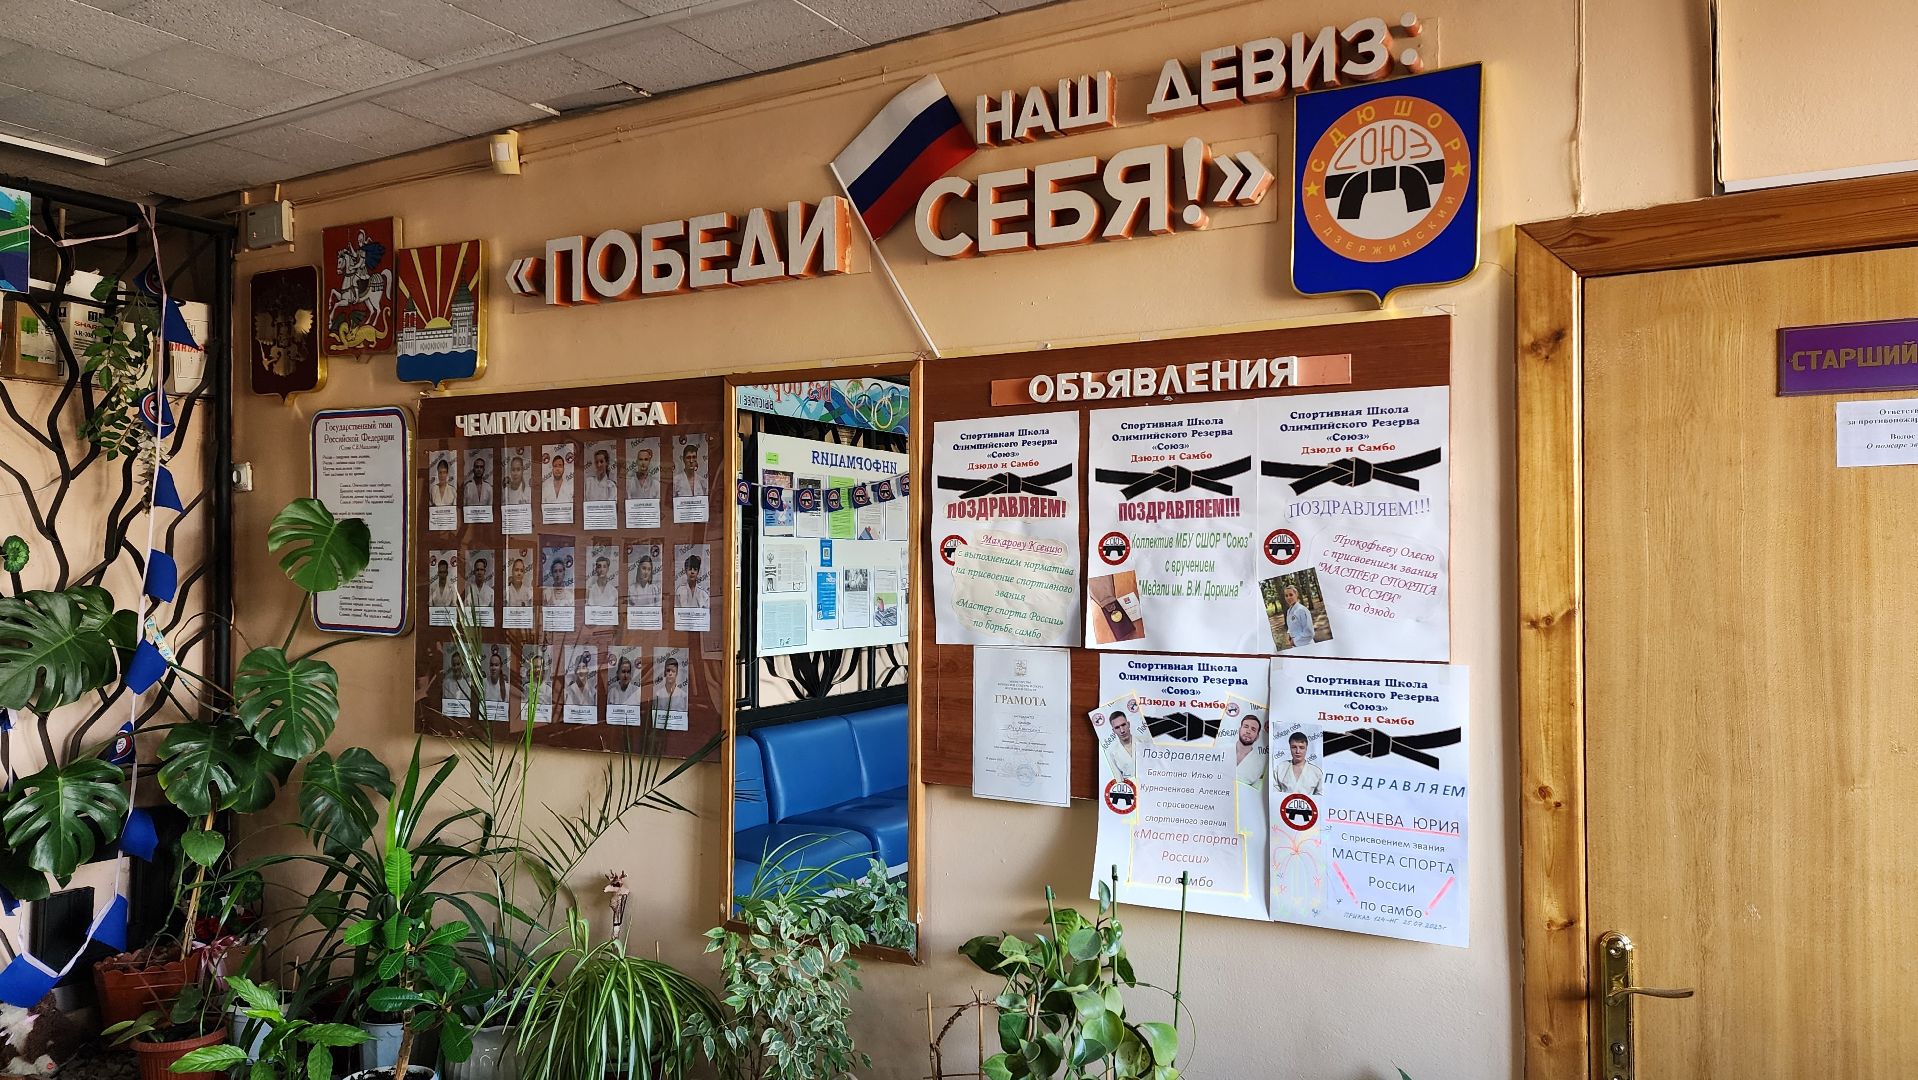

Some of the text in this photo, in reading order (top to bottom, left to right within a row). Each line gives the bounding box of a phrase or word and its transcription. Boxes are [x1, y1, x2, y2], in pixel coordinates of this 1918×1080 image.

[976, 12, 1422, 145] НАШ ДЕВИЗ:
[1310, 100, 1461, 173] СДЮШОР
[1334, 124, 1432, 170] СОЮЗ
[505, 137, 1274, 305] «ПОБЕДИ СЕБЯ!»
[74, 320, 101, 330] SHAR
[1791, 340, 1918, 371] СТАРШИЙ
[1029, 356, 1298, 404] ОБЪЯВЛЕНИЯ
[456, 401, 667, 437] ЧЕМПИОНЫ КЛУБА
[1290, 406, 1409, 421] Спортивная Школа
[1120, 417, 1224, 431] Спортивная Школа
[1280, 418, 1420, 432] Олимпийского Резерва
[324, 432, 395, 444] Российской Федерации
[960, 429, 1050, 441] Спортивная Школа
[1112, 429, 1233, 442] Олимпийского Резерва
[1326, 432, 1370, 441] «Союз»
[953, 439, 1058, 451] Олимпийского Резерва
[1152, 443, 1190, 451] «Союз»
[1301, 446, 1341, 456] Дзюдо
[1357, 443, 1396, 452] Самбо
[987, 451, 1020, 459] «Союз»
[1131, 454, 1165, 463] Дзюдо
[1179, 451, 1213, 460] Самбо
[967, 463, 998, 471] Дзюдо
[1010, 459, 1040, 468] Самбо
[947, 496, 1067, 521] ПОЗДРАВЛЯЕМ!
[1118, 498, 1240, 524] ПОЗДРАВЛЯЕМ!!!
[1288, 497, 1430, 519] ПОЗДРАВЛЯЕМ!!!
[981, 535, 1063, 554] Макарову Ксению
[1131, 532, 1253, 549] Коллектив МБУ СШОР "Союз"
[1333, 534, 1435, 562] Прокофьеву Олесю
[964, 552, 1021, 567] выполнением
[1024, 561, 1074, 576] норматива
[1165, 559, 1215, 576] с вручением
[1323, 549, 1438, 580] с присвоением звания
[955, 566, 1073, 594] на присвоение спортивного
[1319, 562, 1438, 596] "МАСТЕР СПОРТА
[995, 590, 1026, 602] звания
[1138, 579, 1244, 601] "Медали им. В.И. Доркина"
[1345, 584, 1402, 603] РОССИИ"
[956, 599, 1064, 626] «Мастер спорта России»
[1348, 602, 1396, 619] по дзюдо
[973, 619, 1041, 639] по борьбе самбо
[1127, 661, 1238, 673] Спортивная Школа
[1118, 672, 1249, 686] Олимпийского Резерва
[1306, 675, 1428, 689] Спортивная Школа
[1161, 686, 1201, 696] «Союз»
[1296, 687, 1440, 703] Олимпийского Резерва
[994, 694, 1047, 707] ГРАМОТА
[1138, 697, 1175, 708] Дзюдо
[1190, 699, 1226, 710] Самбо
[1343, 702, 1389, 712] «Союз»
[1317, 712, 1360, 723] Дзюдо
[1376, 714, 1415, 726] Самбо
[1142, 748, 1226, 763] Поздравляем!
[1191, 771, 1214, 780] Илью
[1140, 783, 1231, 796] Курначенкова Алексея
[1324, 773, 1466, 798] ПОЗДРАВЛЯЕМ
[1162, 801, 1215, 811] присвоением
[1145, 815, 1227, 827] спортивного звания
[1328, 808, 1460, 834] РОГАЧЕВА ЮРИЯ
[1133, 829, 1238, 846] «Мастер спорта
[1341, 833, 1445, 853] С присвоением звания
[1161, 851, 1210, 865] России»
[1332, 848, 1455, 874] МАСТЕРА СПОРТА
[1157, 875, 1214, 888] по смбо
[1368, 876, 1415, 894] России
[1360, 901, 1423, 919] по самбо
